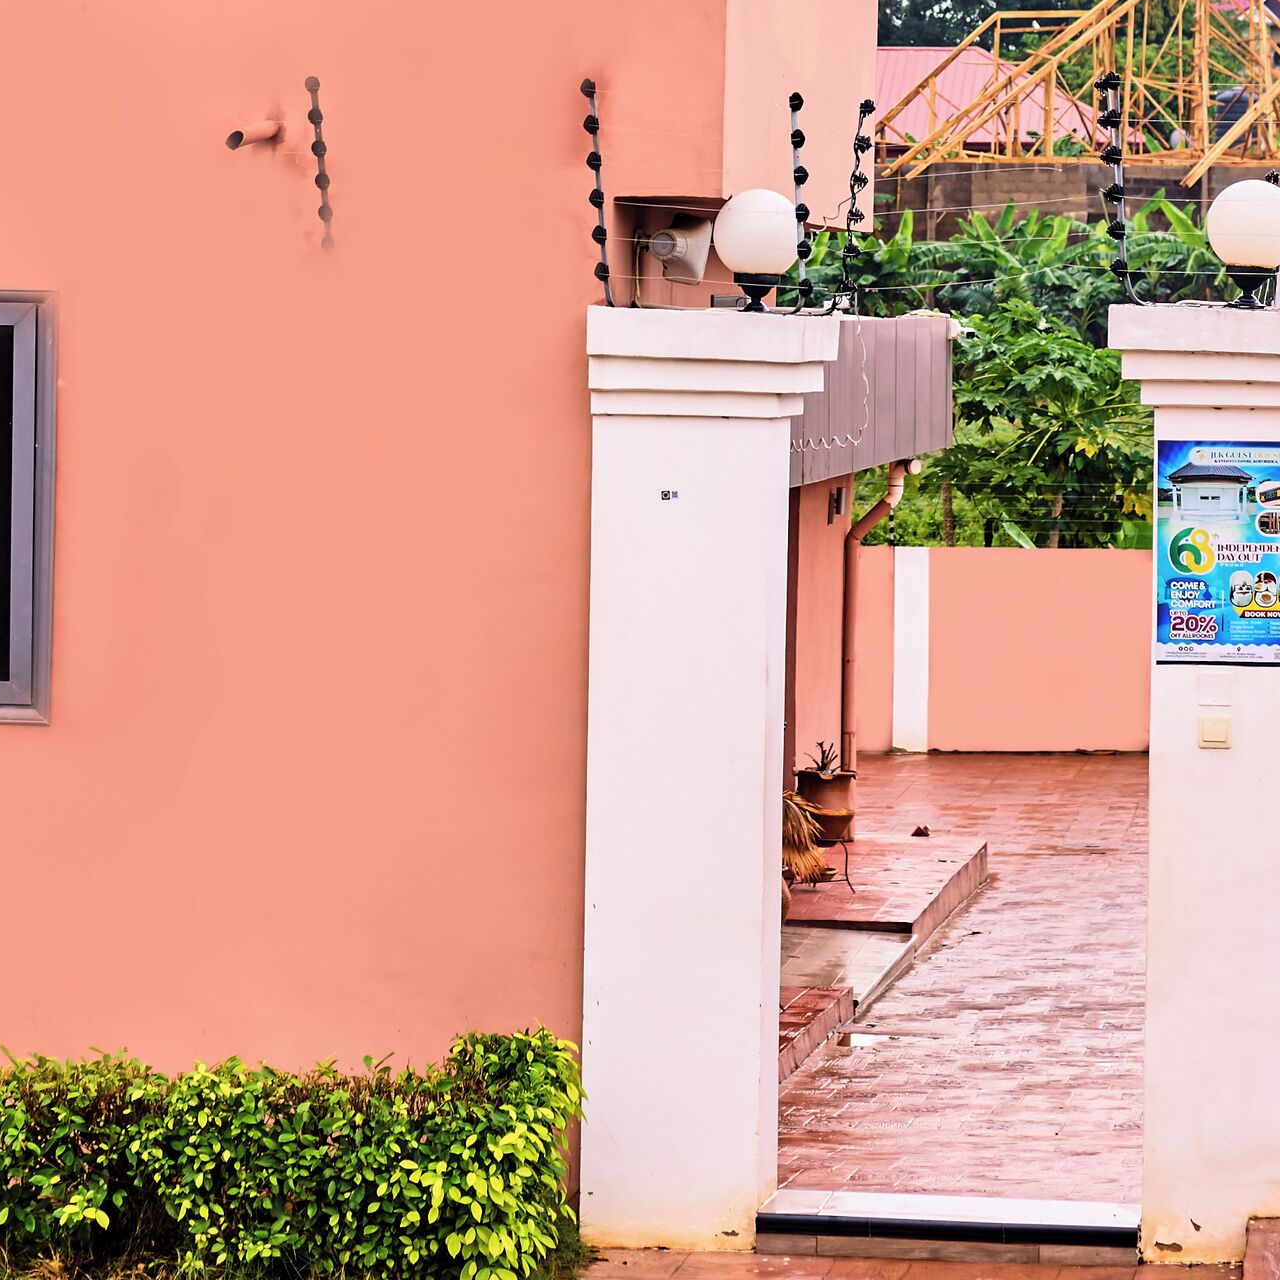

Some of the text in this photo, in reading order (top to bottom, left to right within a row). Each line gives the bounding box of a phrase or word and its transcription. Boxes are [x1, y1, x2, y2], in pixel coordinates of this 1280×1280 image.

[1217, 553, 1260, 562] DAY OUT
[1170, 581, 1206, 590] COME &
[1170, 591, 1200, 599] ENJOY
[1170, 600, 1217, 608] COMFORT
[1171, 616, 1217, 632] 20%
